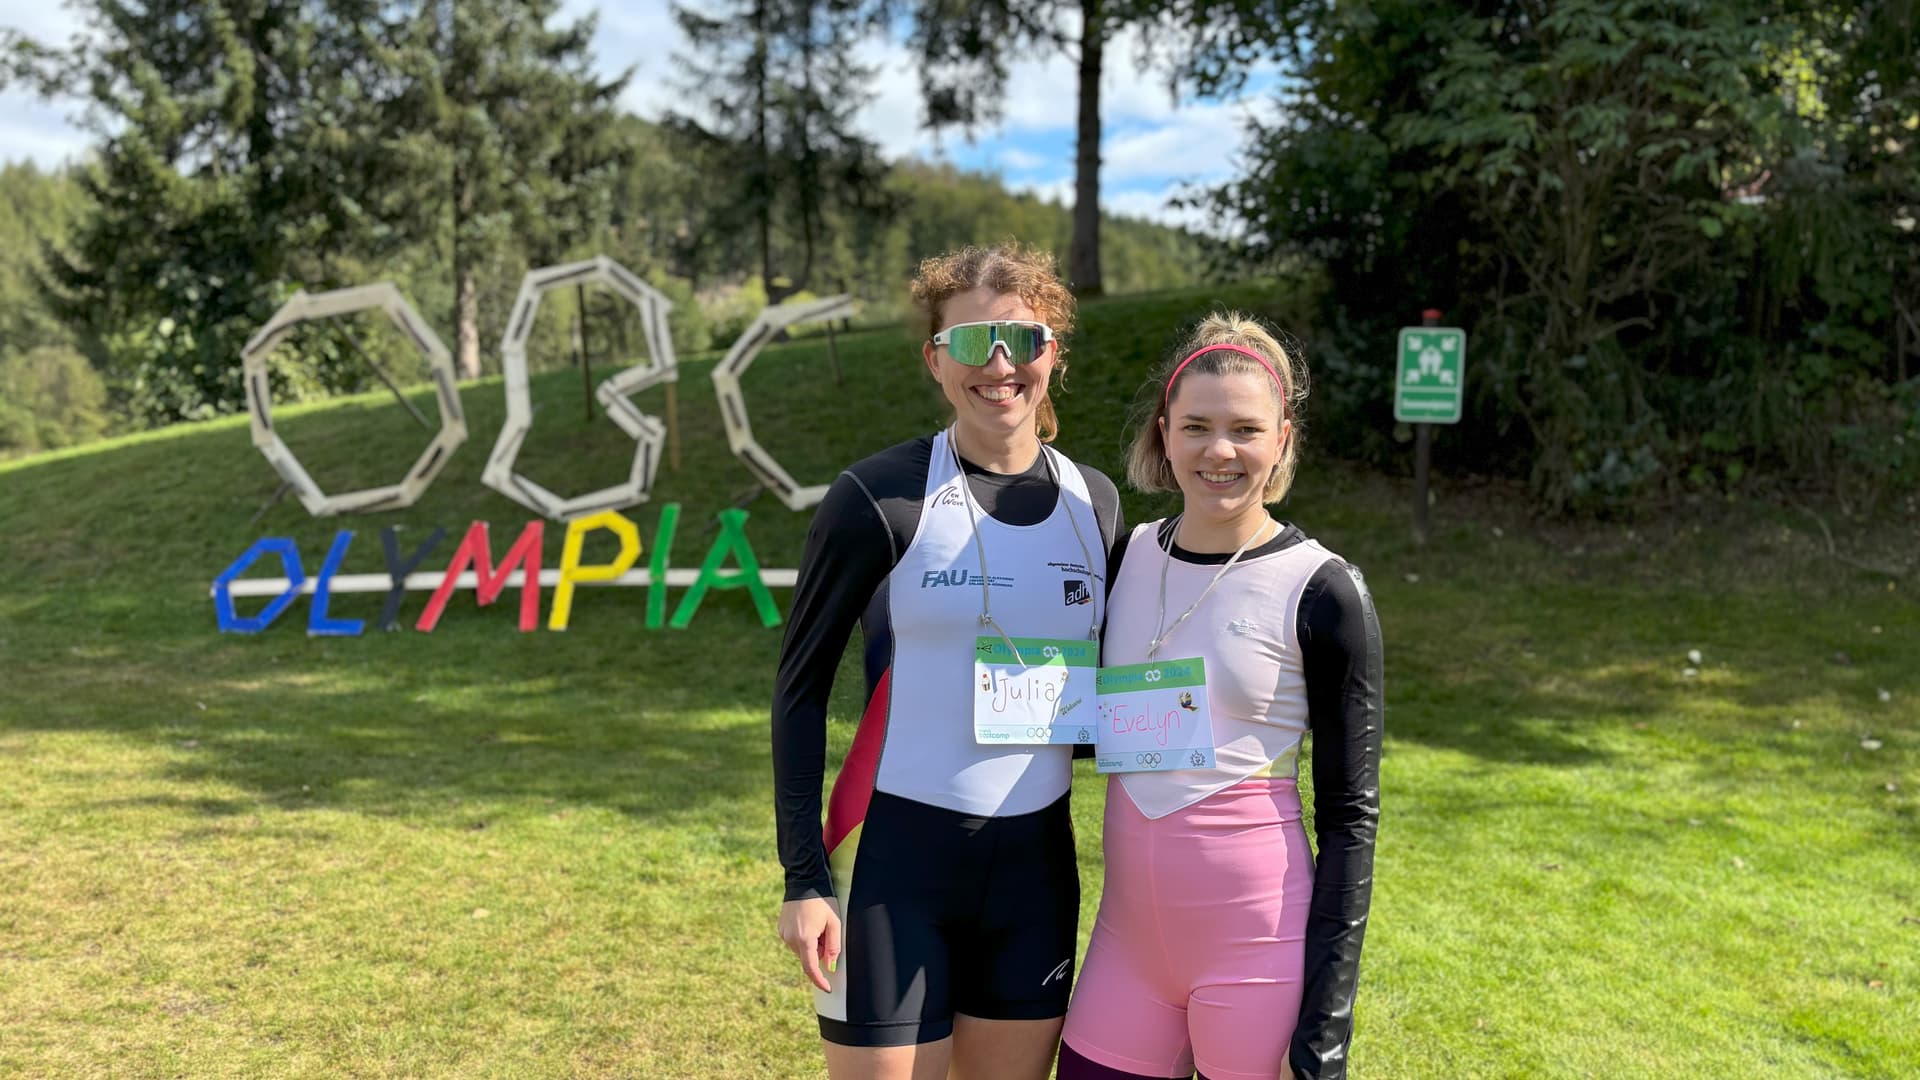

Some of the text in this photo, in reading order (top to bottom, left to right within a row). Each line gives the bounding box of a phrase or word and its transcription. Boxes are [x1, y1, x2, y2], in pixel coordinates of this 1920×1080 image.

[213, 503, 782, 636] OLYMPIA
[921, 569, 968, 588] FAU
[992, 677, 1055, 712] Julia
[1112, 703, 1180, 746] Evelyn
